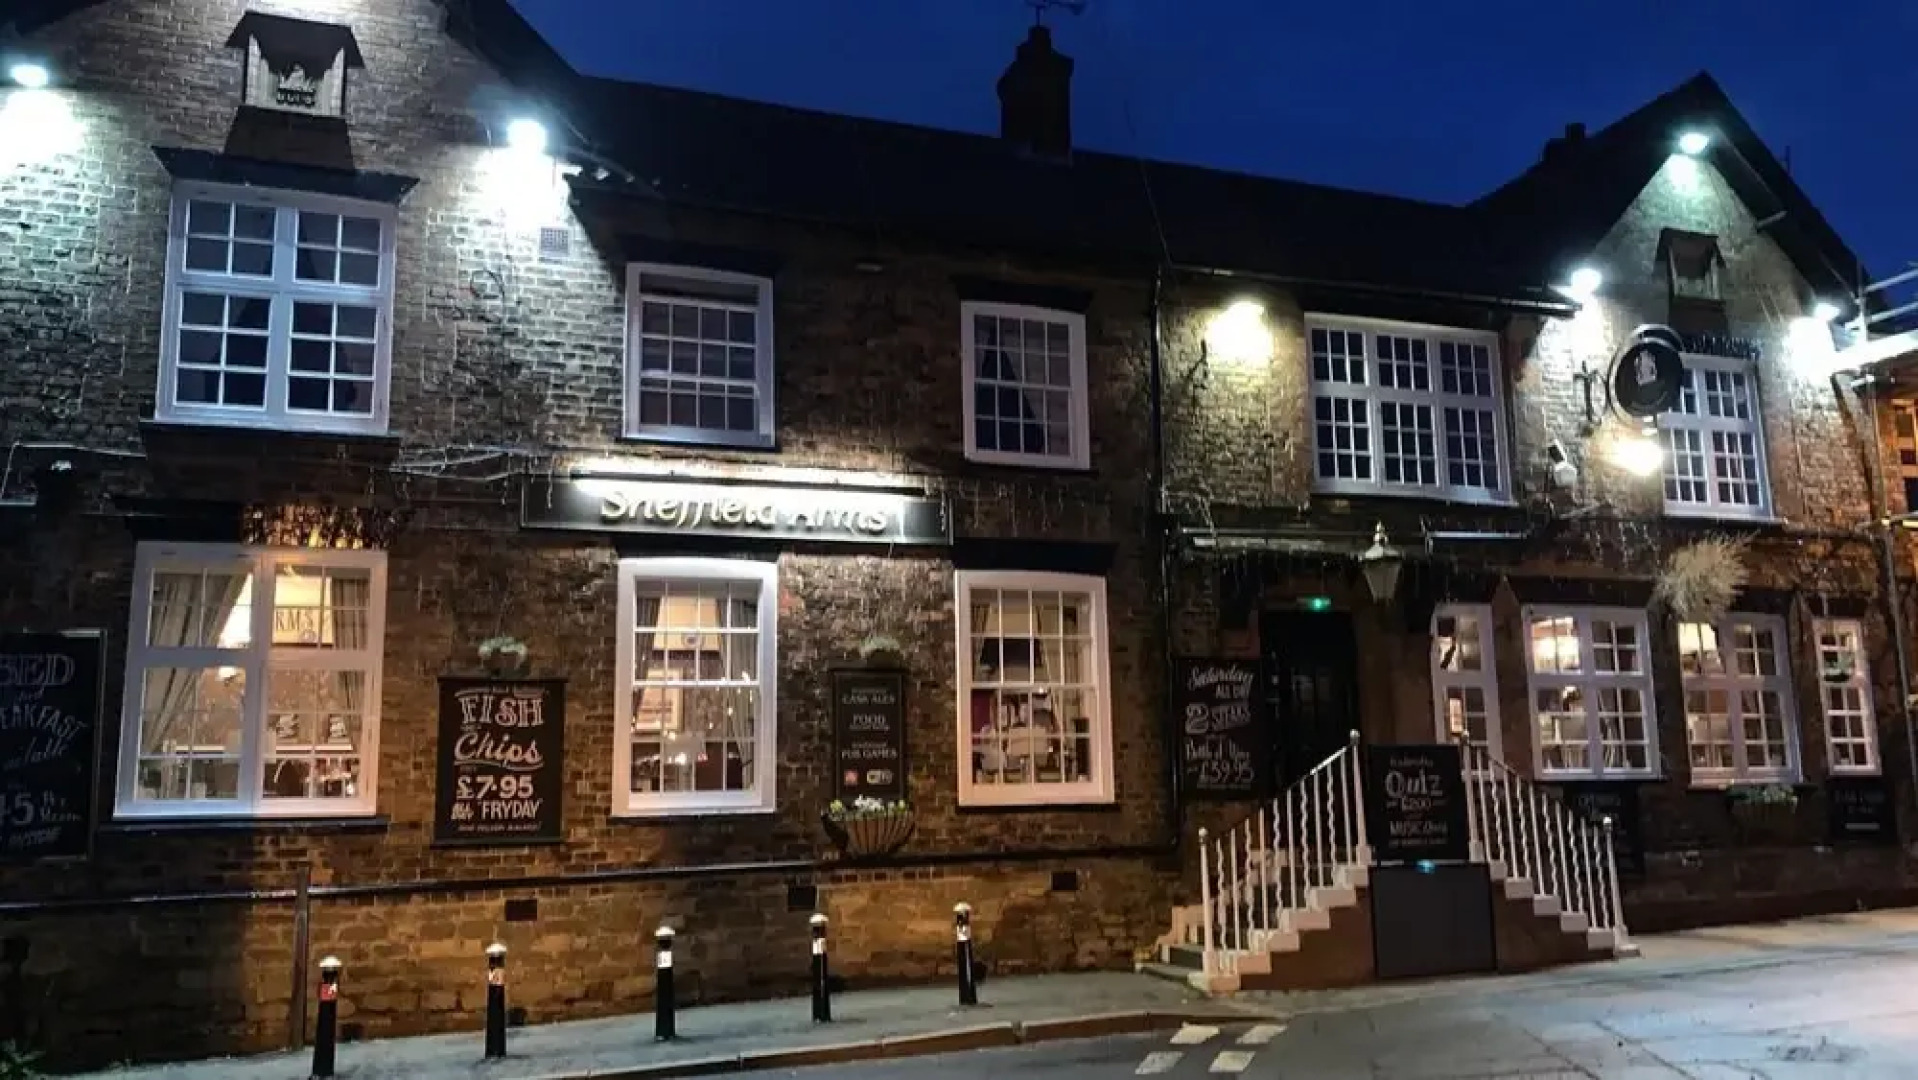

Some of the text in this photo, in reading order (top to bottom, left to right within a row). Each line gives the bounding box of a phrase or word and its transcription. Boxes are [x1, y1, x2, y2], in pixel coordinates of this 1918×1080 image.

[601, 489, 887, 533] Sheffield Arms
[1187, 664, 1254, 692] Saturday
[457, 694, 544, 728] FISH
[1185, 703, 1209, 734] 2
[454, 732, 543, 768] Chips
[1385, 769, 1444, 799] Quiz
